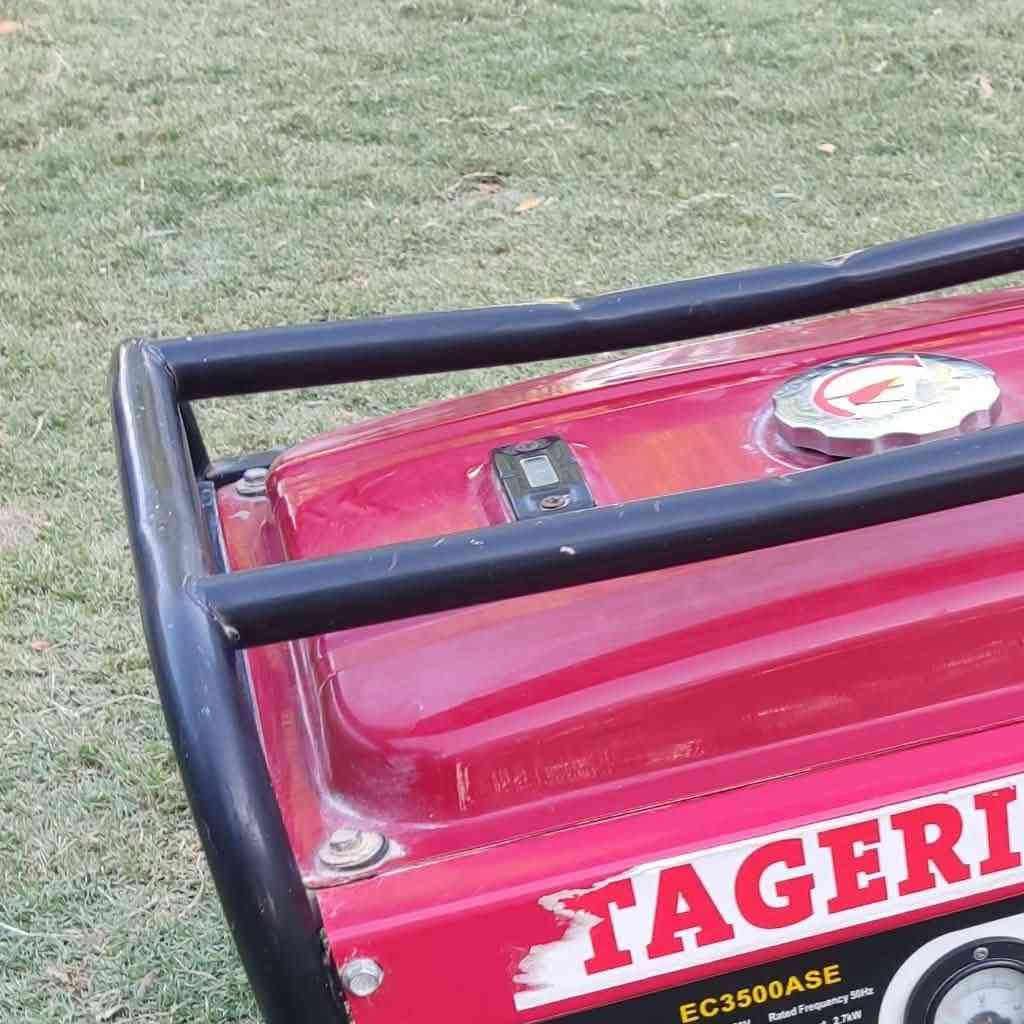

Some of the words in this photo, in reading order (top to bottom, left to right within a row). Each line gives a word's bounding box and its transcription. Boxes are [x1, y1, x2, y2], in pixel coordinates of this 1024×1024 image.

[577, 785, 1022, 976] TAGERI
[680, 965, 841, 1024] EC3500ASE
[768, 1006, 797, 1022] Rated
[798, 994, 849, 1014] Frequency
[850, 987, 874, 1000] 50Hz
